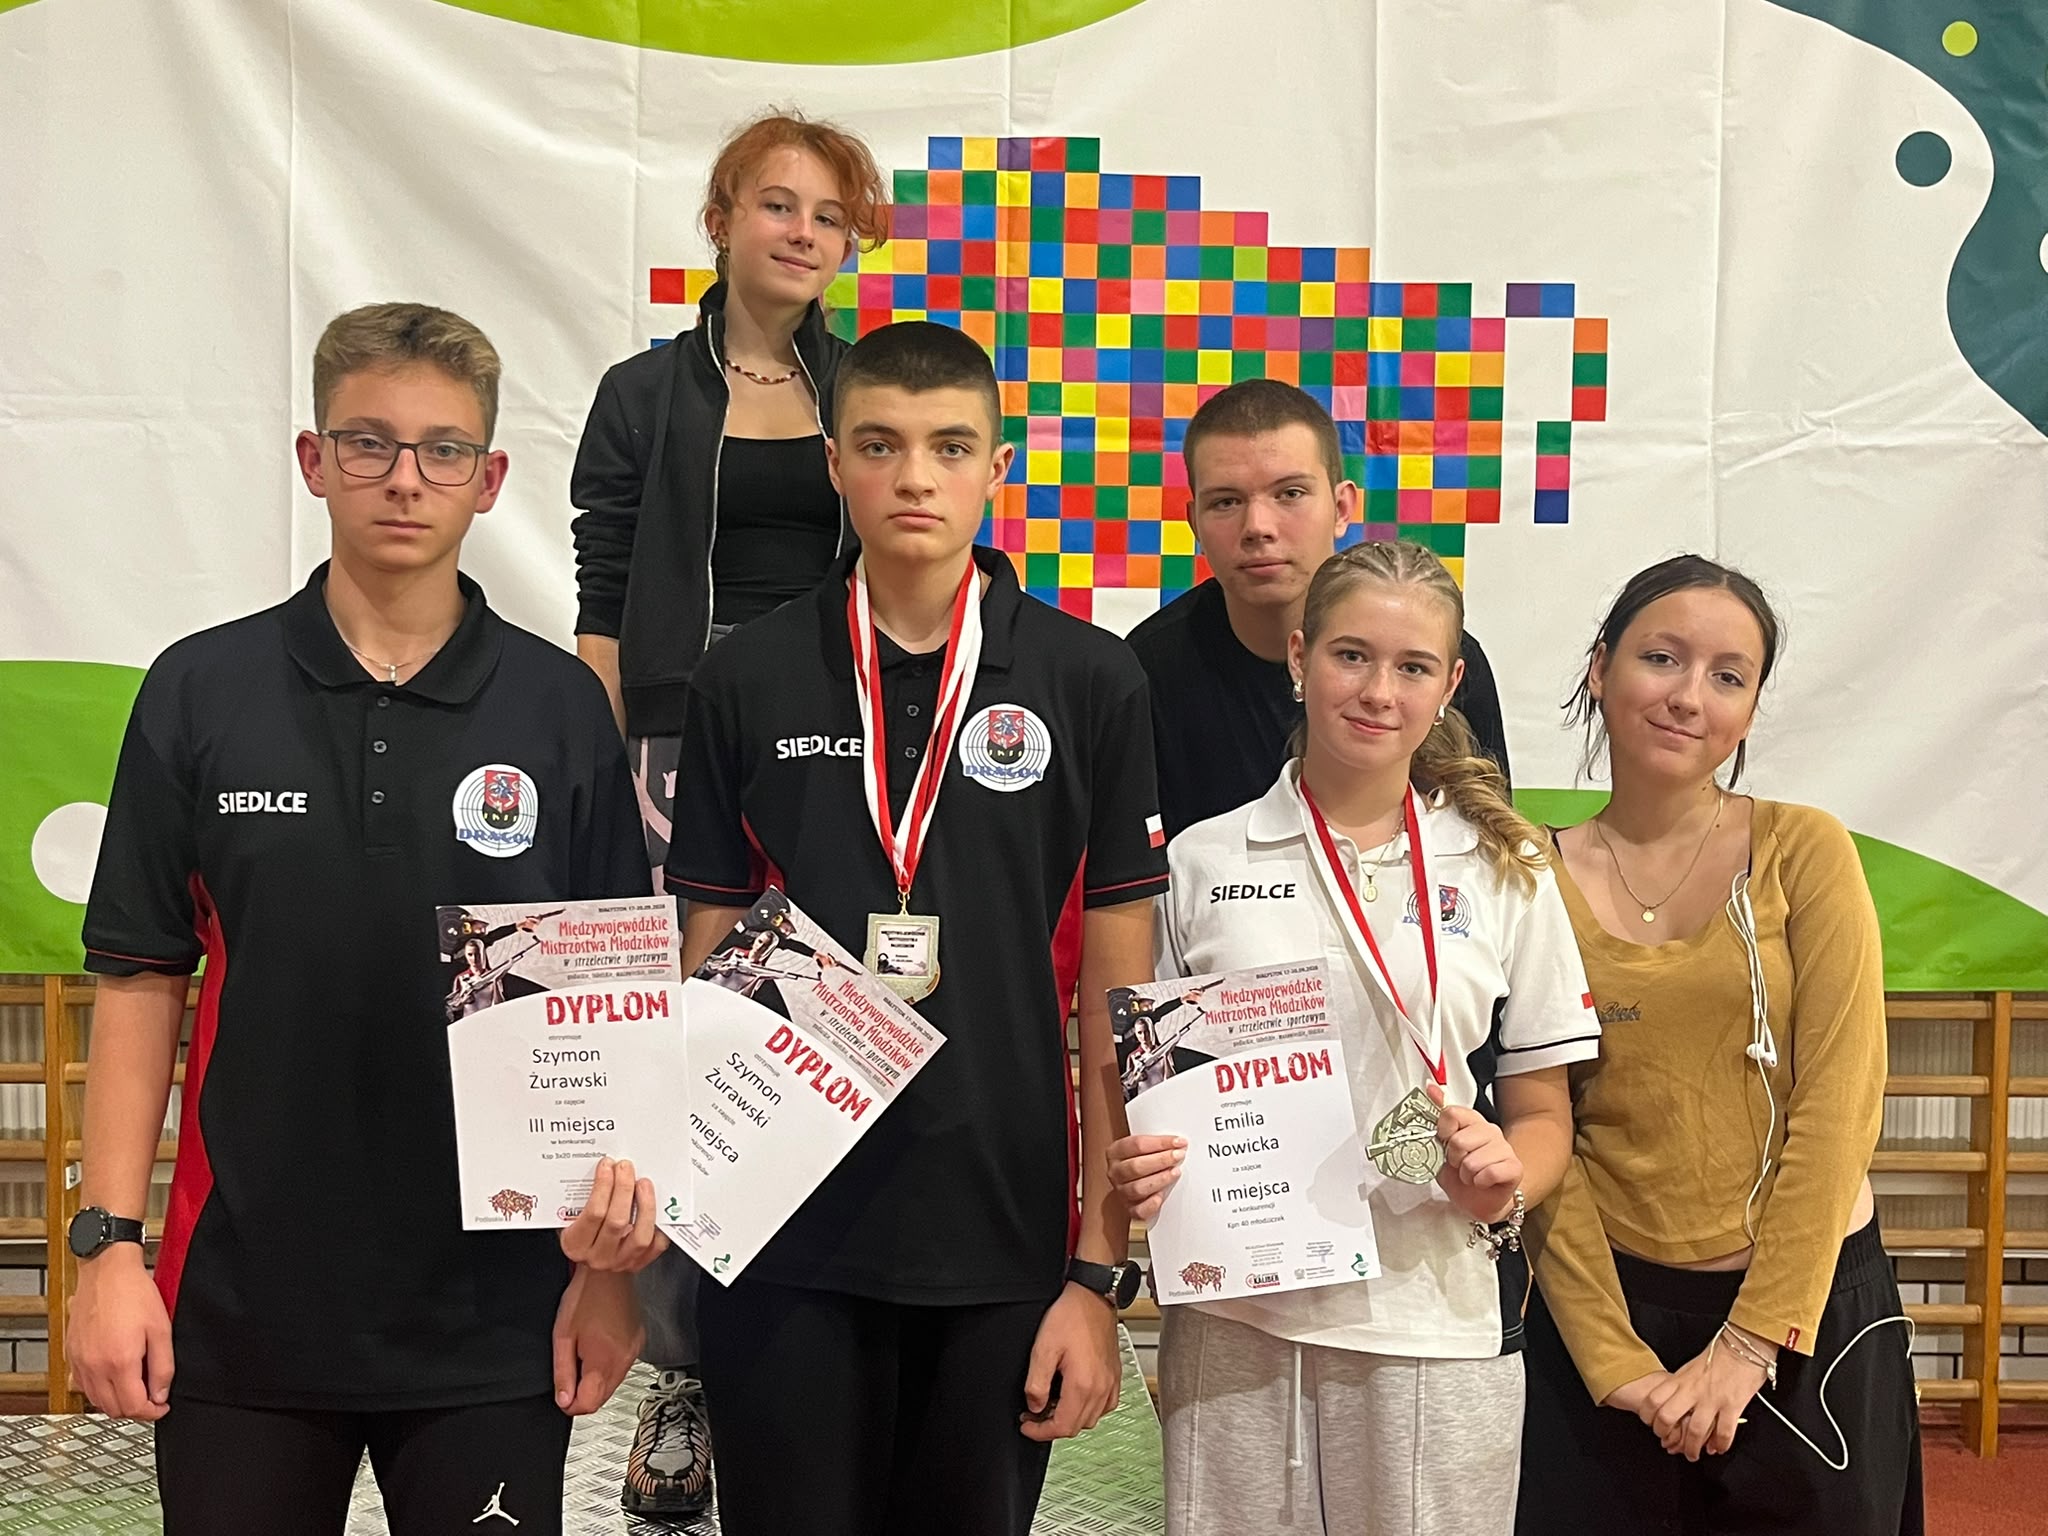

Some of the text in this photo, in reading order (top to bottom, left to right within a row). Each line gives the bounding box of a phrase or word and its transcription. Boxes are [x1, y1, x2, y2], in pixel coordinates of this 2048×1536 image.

[776, 735, 863, 759] SIEDLCE
[218, 791, 308, 814] SIEDLCE
[1210, 883, 1296, 903] SIEDLCE
[558, 916, 668, 939] Międzywojewódzkie
[540, 934, 670, 955] Mistrzostwa Młodzików
[563, 958, 570, 967] w
[626, 952, 668, 965] sportowym
[1220, 978, 1323, 1006] Międzywojewódzkie
[545, 990, 669, 1026] DYPLOM
[838, 979, 924, 1058] Międzywojewódzkie
[1204, 995, 1326, 1025] Mistrzostwa Młodzików
[1287, 1012, 1326, 1027] sportowym
[812, 981, 867, 1032] Mistrzostwa
[864, 1025, 914, 1071] Młodzików
[532, 1048, 601, 1066] Szymon
[865, 1049, 901, 1080] sportowym
[529, 1071, 607, 1089] Żurawski
[726, 1052, 782, 1106] Szymon
[765, 1023, 873, 1122] DYPLOM
[1214, 1048, 1333, 1094] DYPLOM
[705, 1067, 772, 1128] Żurawski
[528, 1117, 615, 1135] III miejsca
[1214, 1111, 1265, 1132] Emilia
[689, 1113, 739, 1163] miejsca
[1208, 1136, 1280, 1158] Nowicka
[1212, 1181, 1290, 1203] II miejsca
